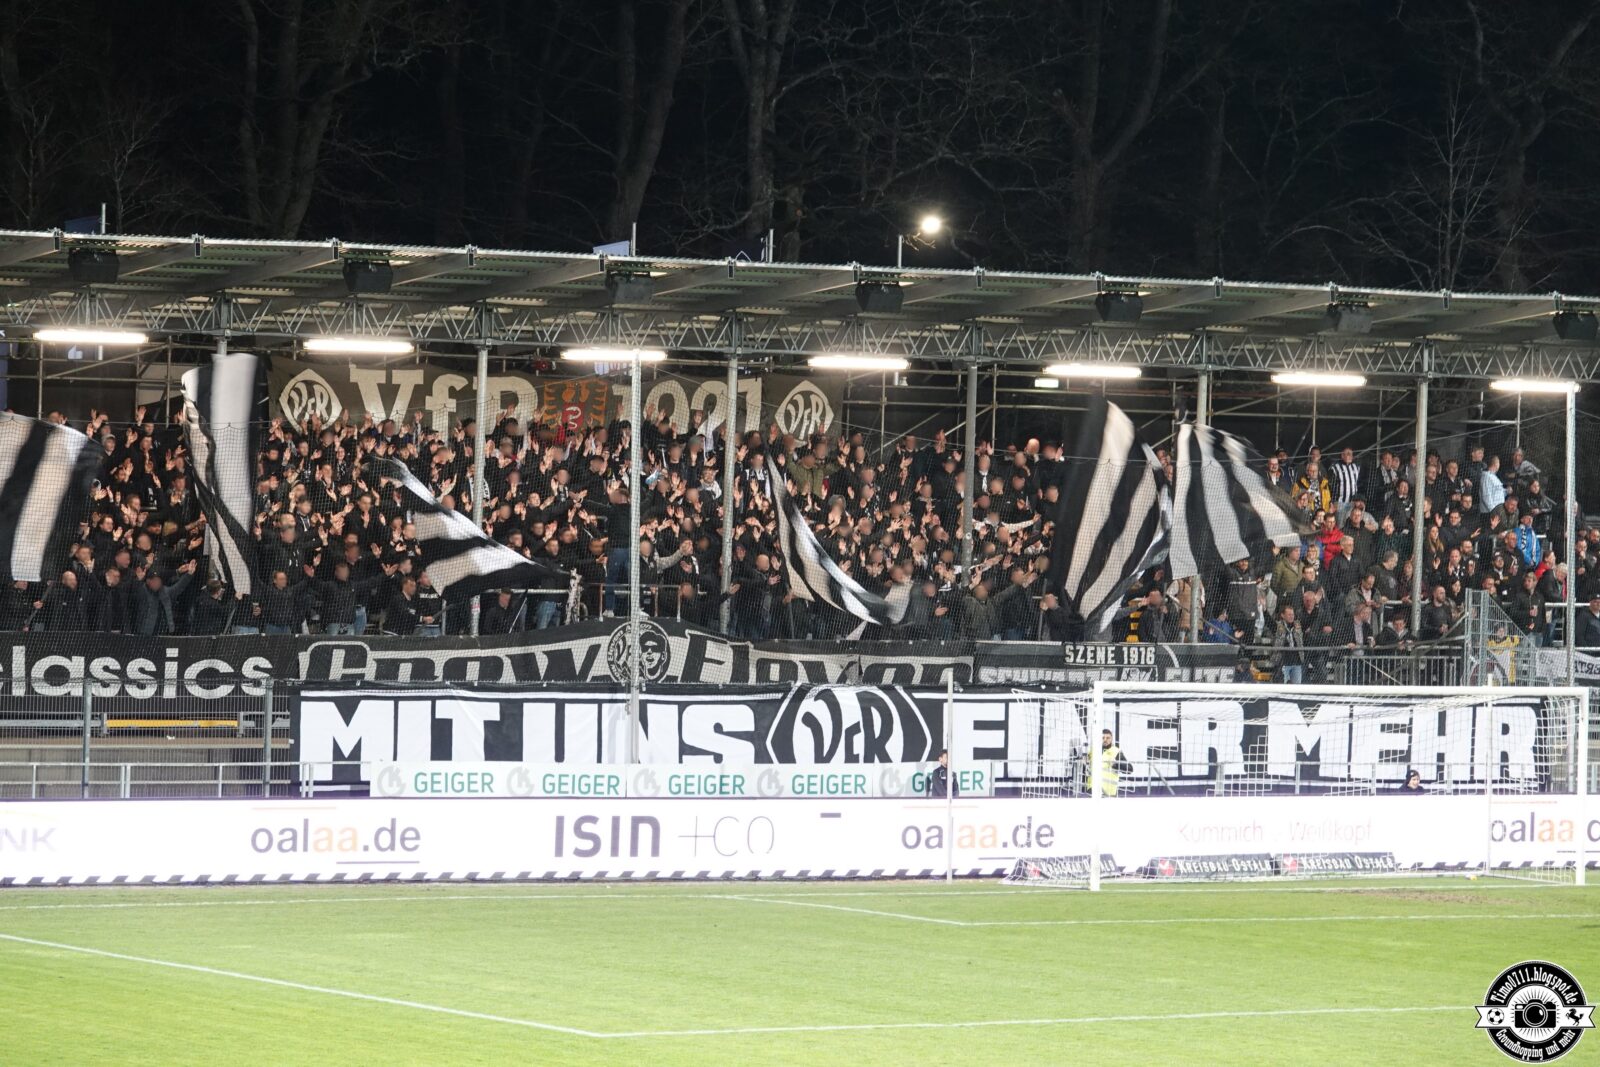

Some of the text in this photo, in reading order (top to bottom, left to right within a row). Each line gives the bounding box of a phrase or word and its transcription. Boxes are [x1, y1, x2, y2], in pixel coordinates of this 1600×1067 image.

[350, 366, 762, 446] VfR 1921
[1065, 645, 1116, 665] SZENE
[0, 645, 273, 699] lassics
[300, 700, 500, 781] MIT
[523, 702, 755, 764] UNS
[943, 701, 1244, 779] EINER
[1268, 701, 1539, 781] MEHR
[414, 772, 494, 793] GEIGER
[542, 773, 620, 795] GEIGER
[668, 774, 745, 795] GEIGER
[791, 774, 866, 795] GEIGER
[911, 771, 984, 793] GER
[250, 818, 421, 853] oalaa.de
[901, 816, 1055, 850] oaaa.de
